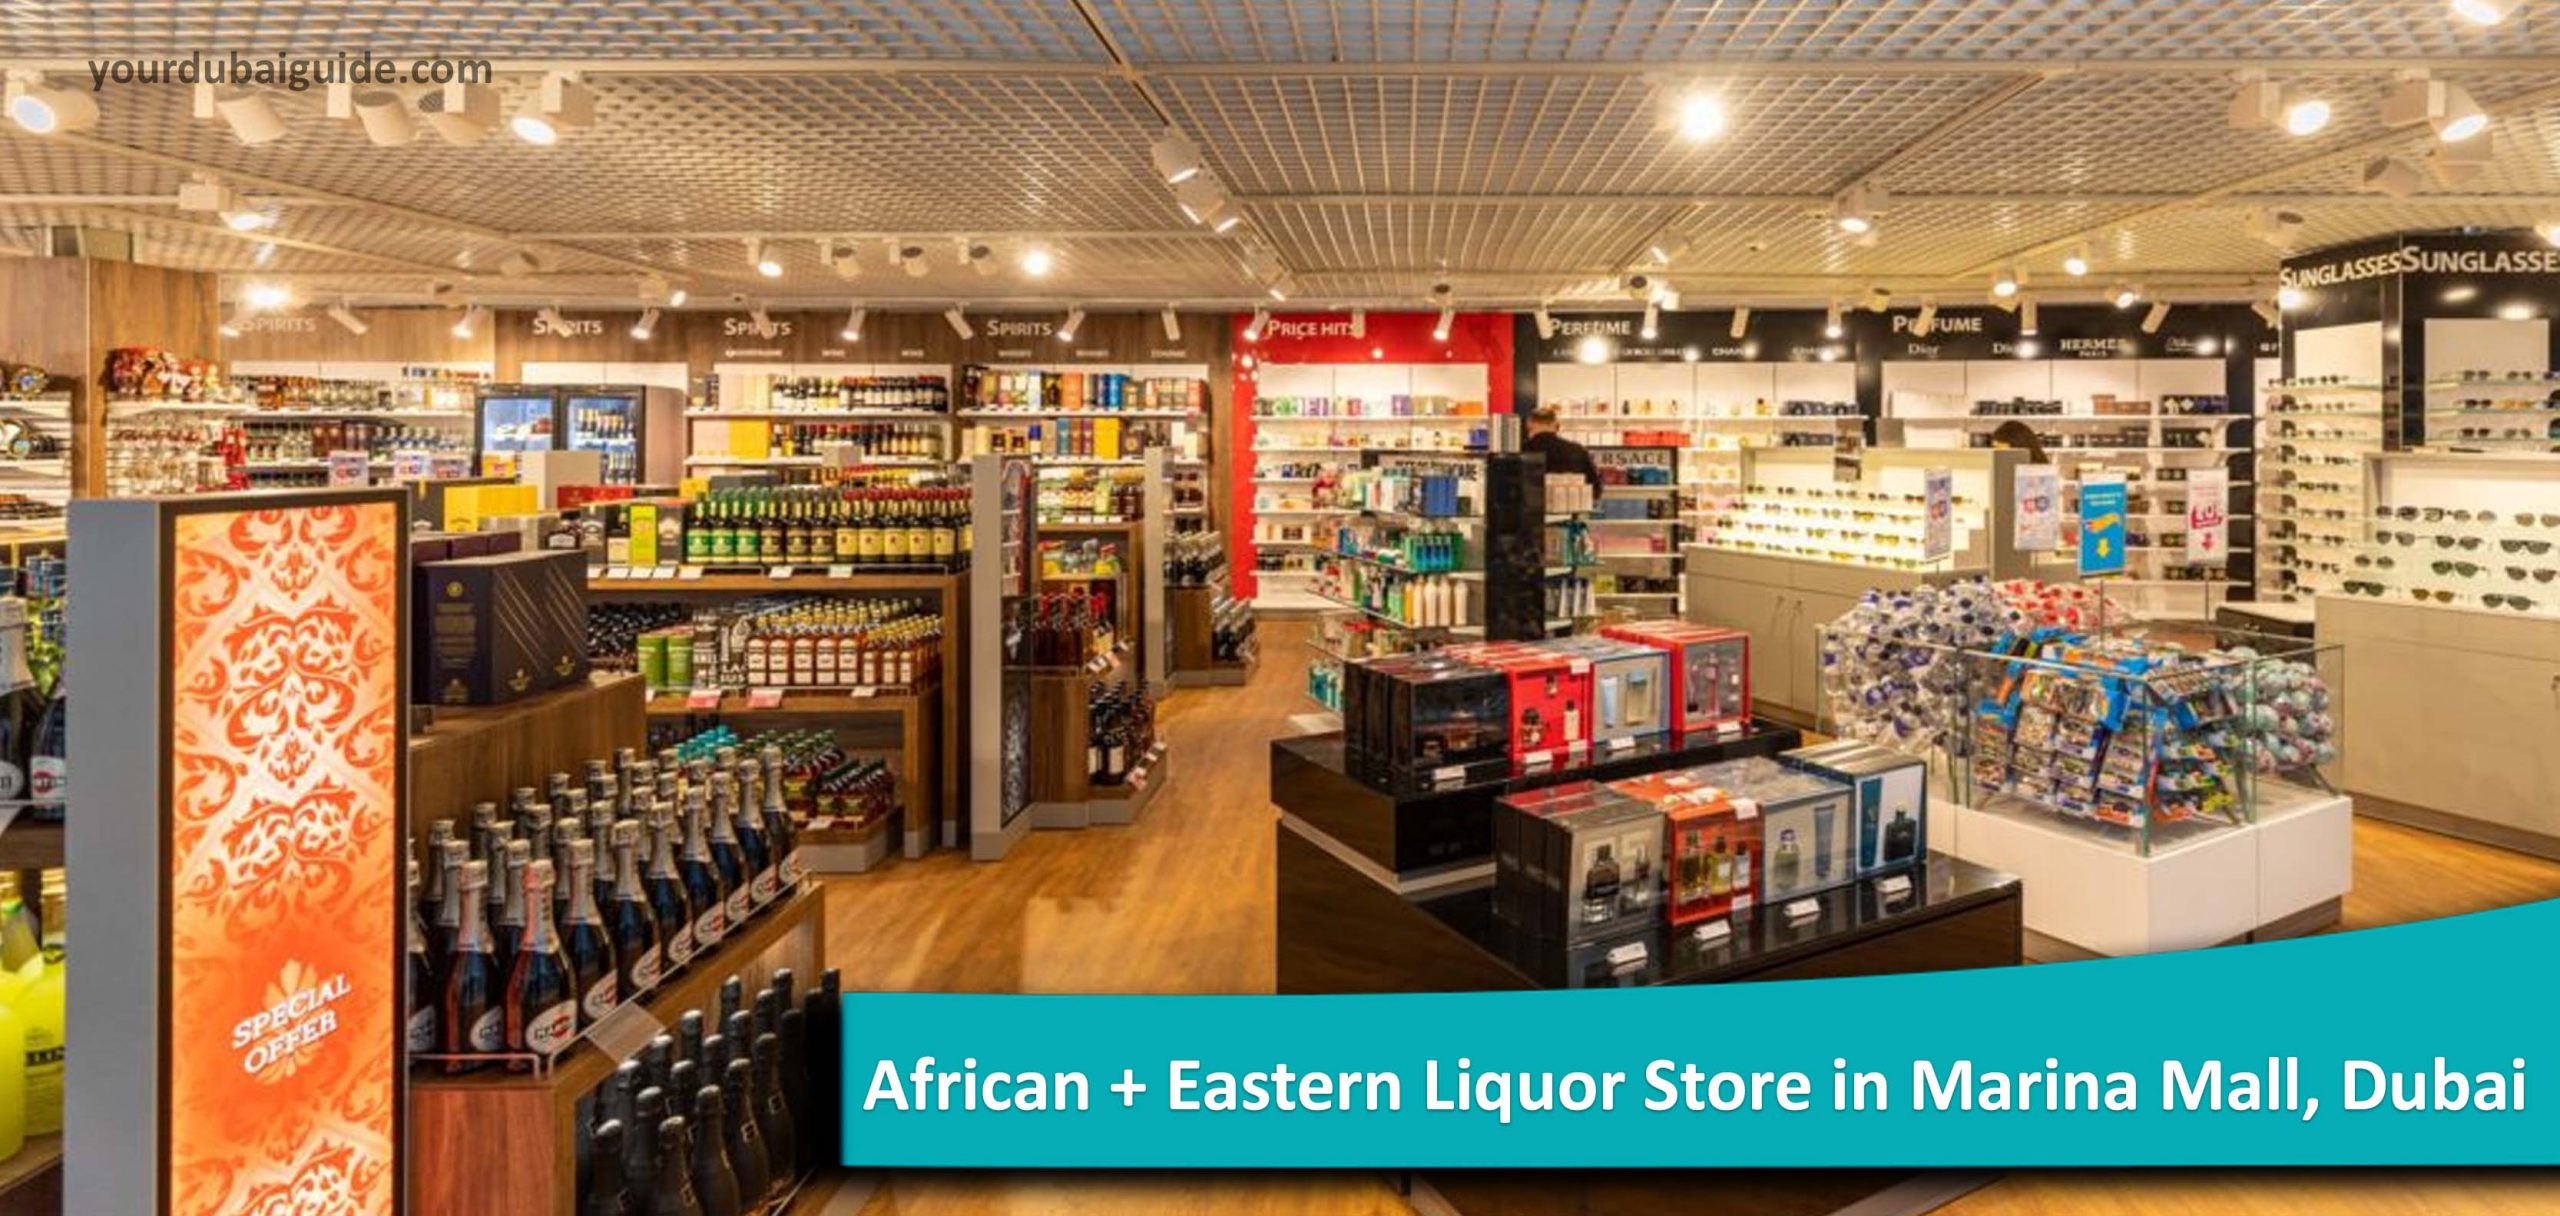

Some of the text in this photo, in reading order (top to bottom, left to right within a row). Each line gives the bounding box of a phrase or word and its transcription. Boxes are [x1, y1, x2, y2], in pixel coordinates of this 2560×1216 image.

[2280, 252, 2401, 290] SUNGLASSES
[2402, 246, 2560, 273] SUNGLASSE
[986, 318, 1052, 337] SPIRITS
[1268, 319, 1318, 337] PRICE
[1550, 319, 1631, 336] PERFUME
[232, 972, 353, 1051] SPECIAL
[243, 1009, 338, 1075] OFFER
